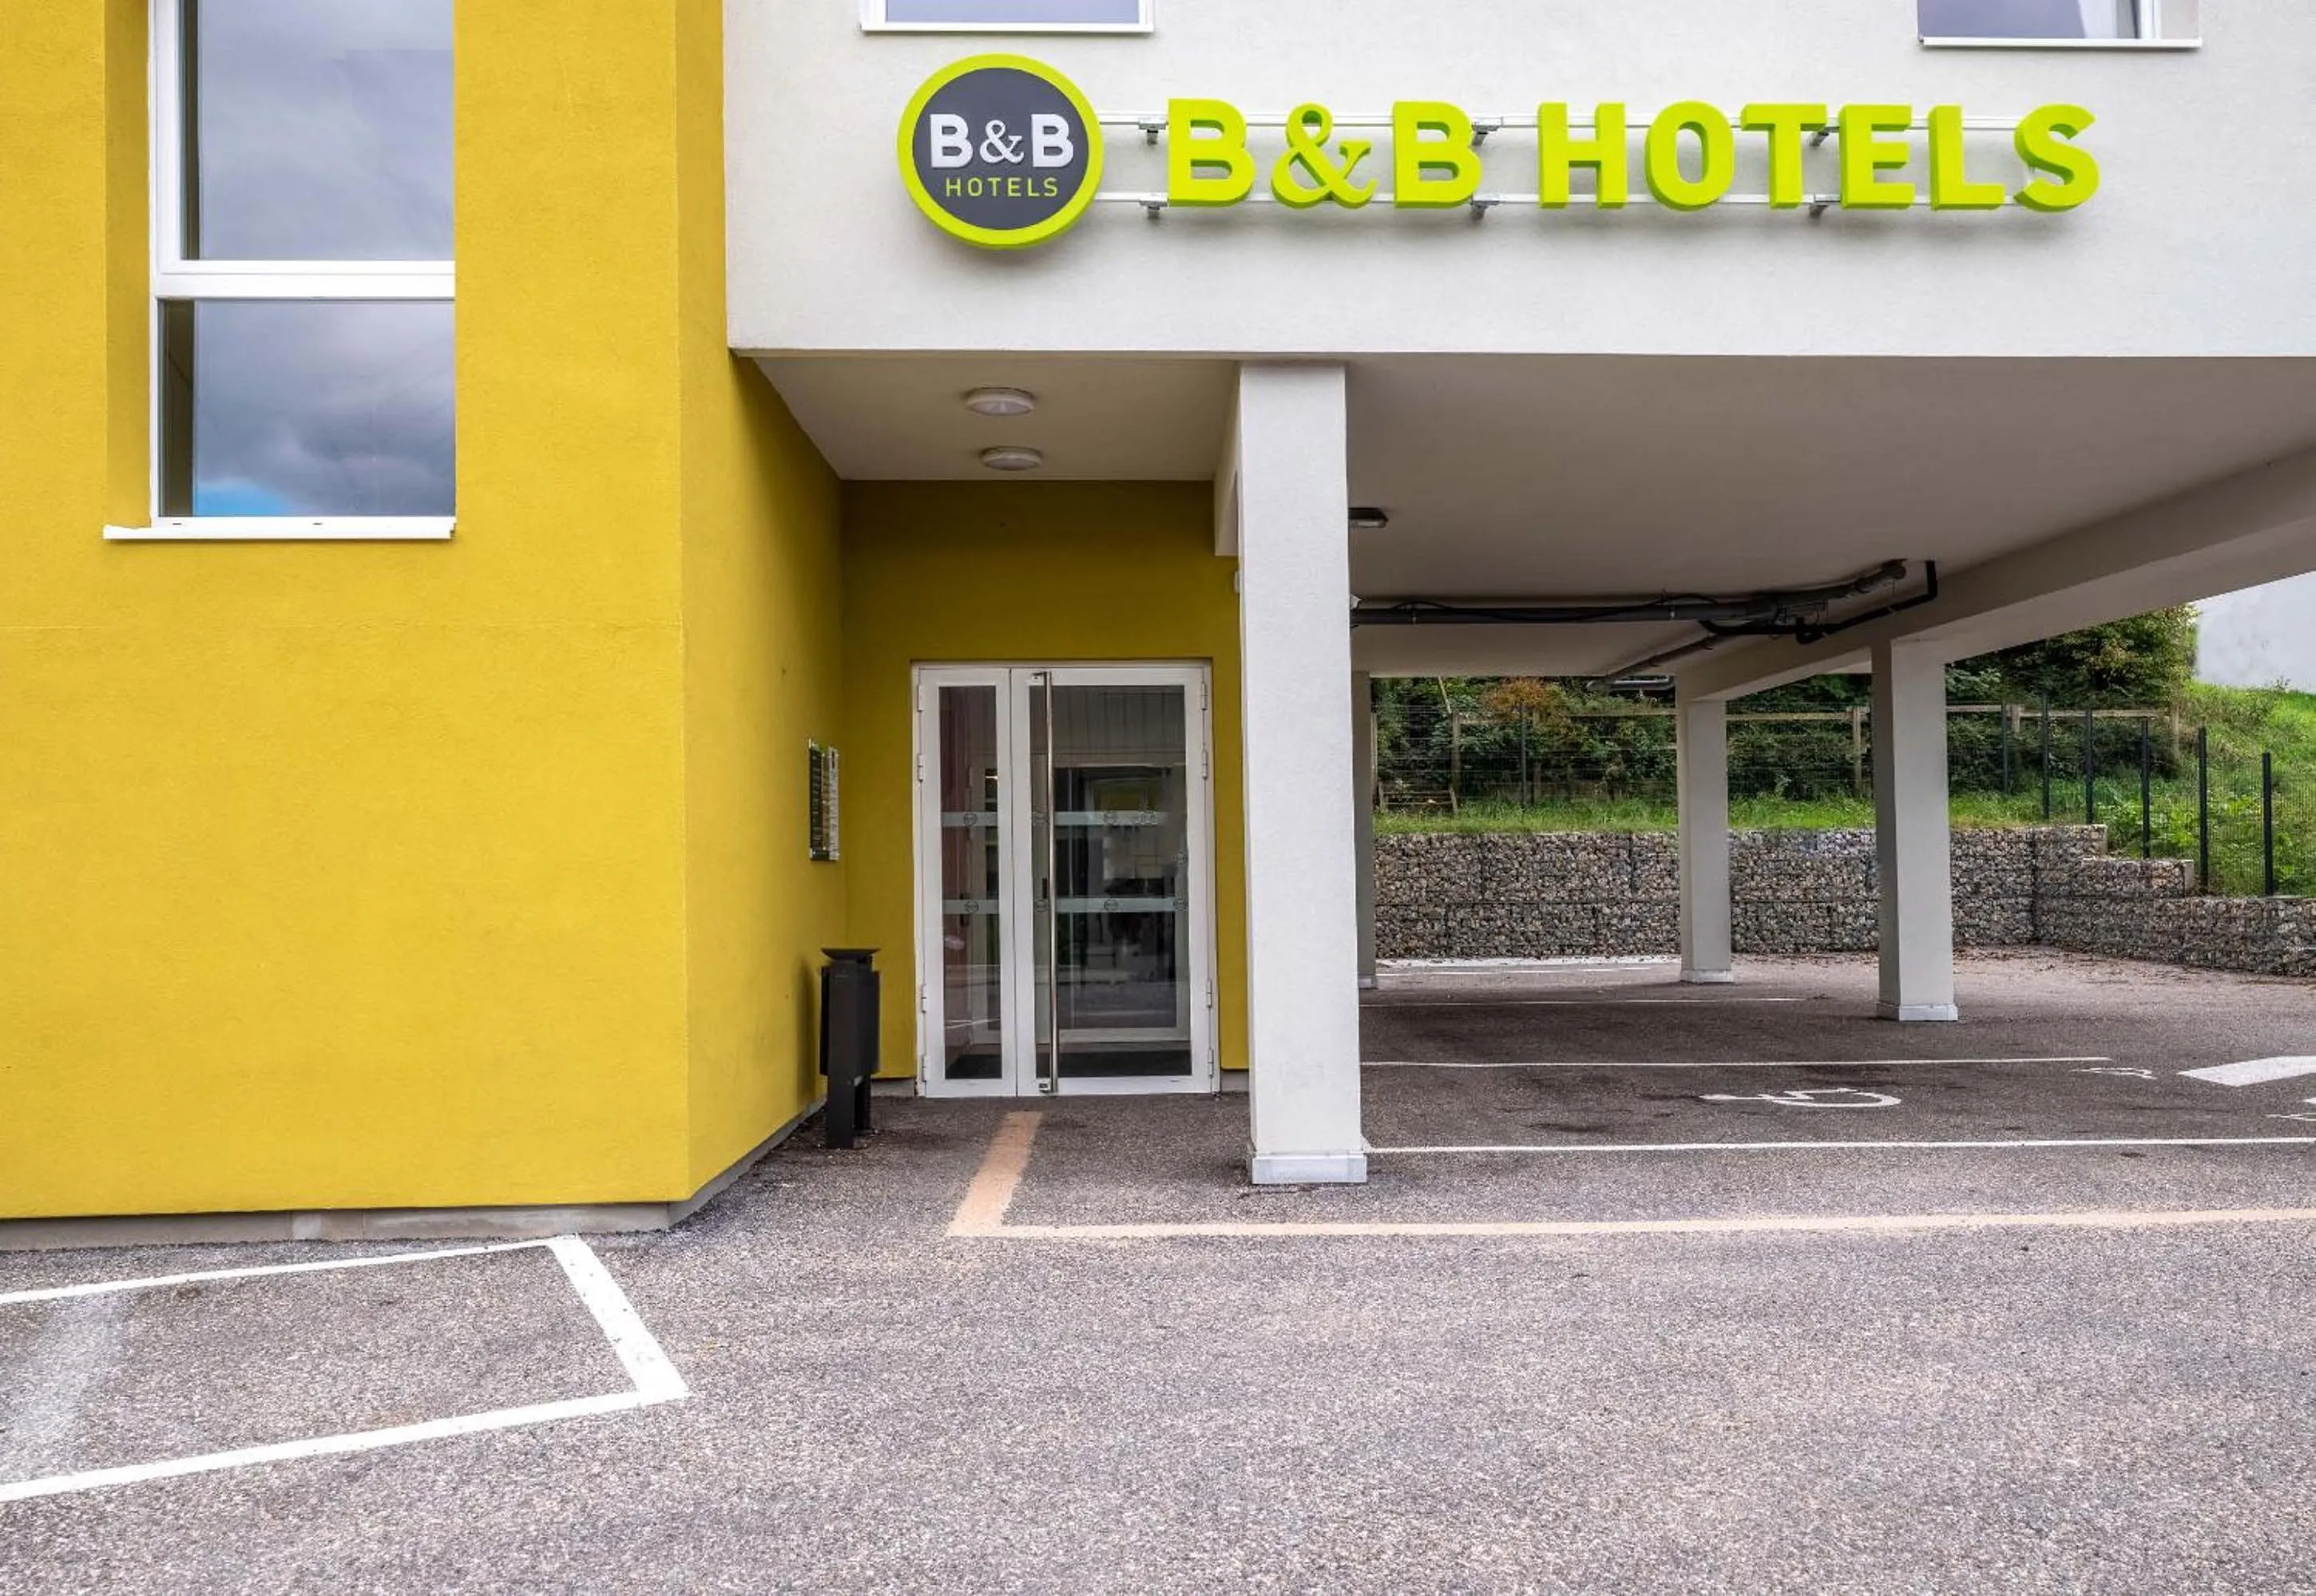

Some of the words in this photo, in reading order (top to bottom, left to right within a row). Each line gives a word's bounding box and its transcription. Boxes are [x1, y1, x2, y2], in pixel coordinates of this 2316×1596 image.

[930, 113, 1074, 168] B&B
[1167, 98, 1483, 209] B&B
[1537, 101, 2100, 212] HOTELS
[945, 176, 1058, 197] HOTELS
